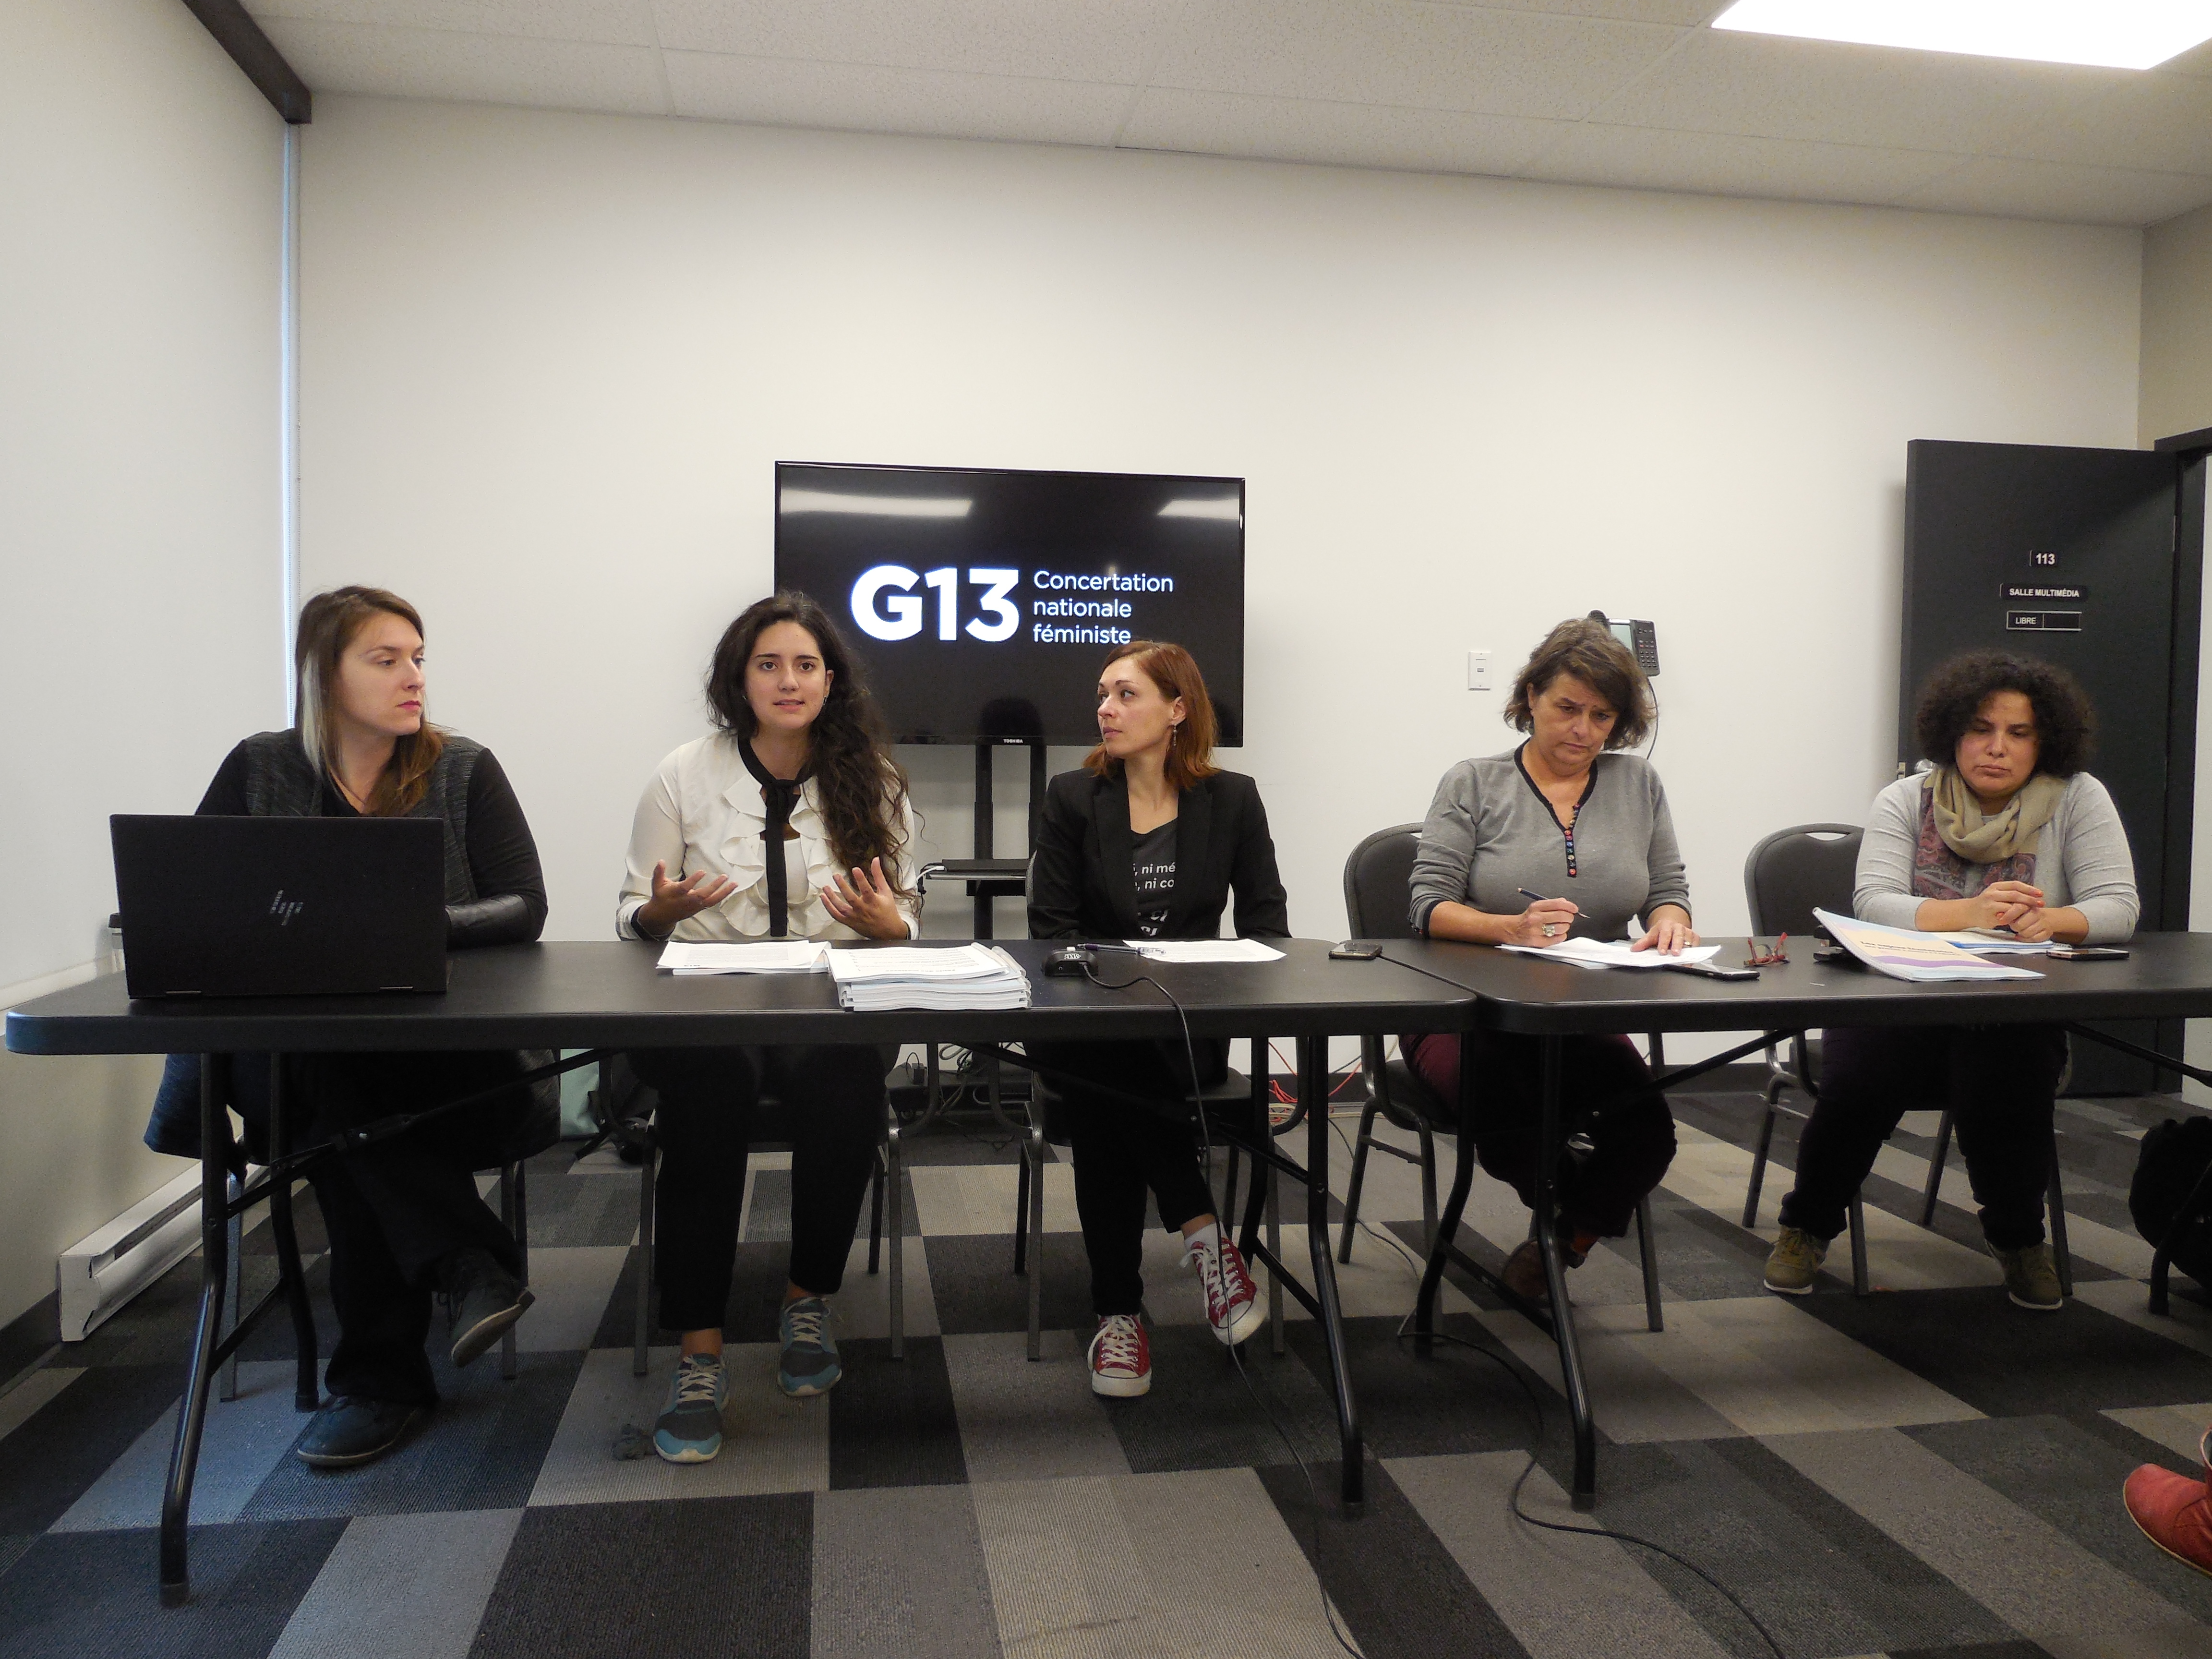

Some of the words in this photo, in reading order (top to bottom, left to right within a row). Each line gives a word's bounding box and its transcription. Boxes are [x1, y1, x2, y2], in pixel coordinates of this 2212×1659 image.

[2036, 553, 2055, 565] 113
[1034, 571, 1173, 592] Concertation
[2035, 589, 2080, 597] MULTIMÉDIA
[851, 565, 1020, 642] G13
[1034, 599, 1132, 618] nationale
[1033, 624, 1131, 644] féministe
[1142, 864, 1153, 874] ni
[1144, 878, 1157, 889] ni
[270, 890, 303, 926] hp
